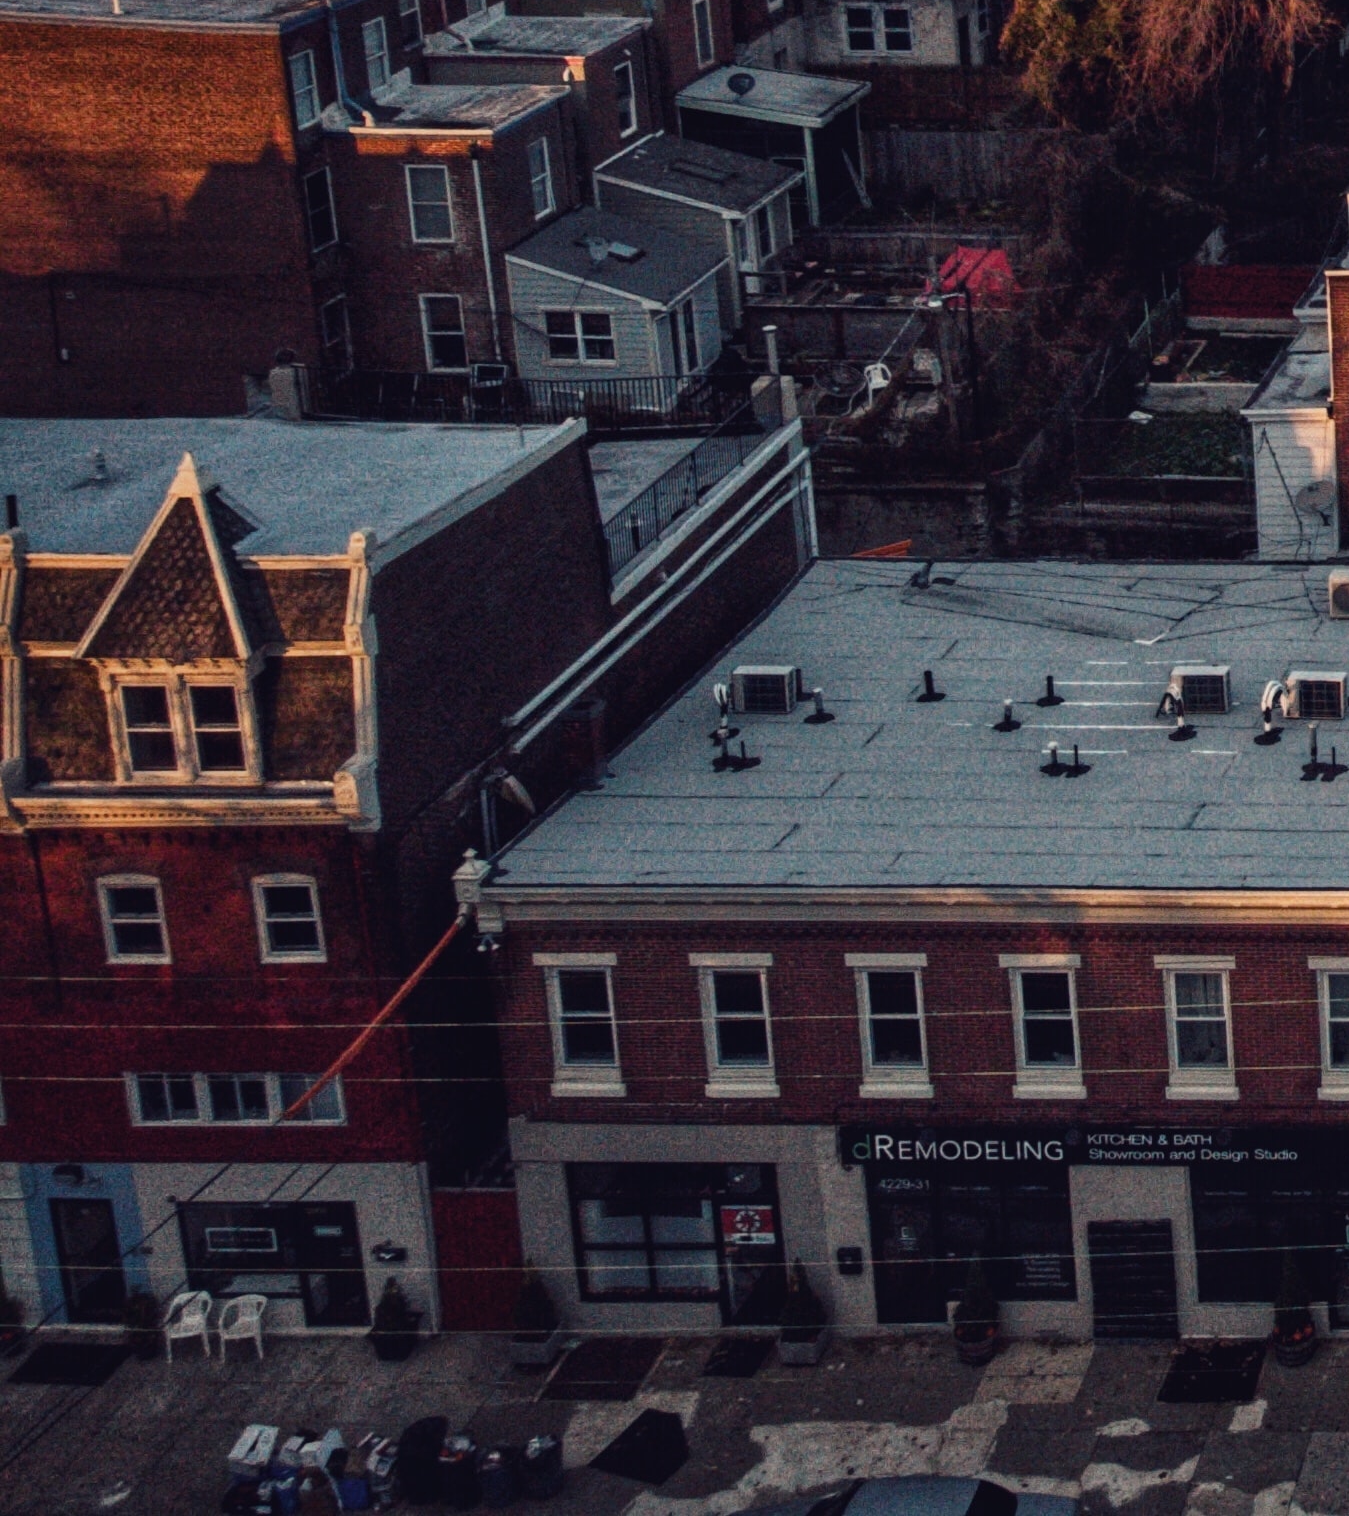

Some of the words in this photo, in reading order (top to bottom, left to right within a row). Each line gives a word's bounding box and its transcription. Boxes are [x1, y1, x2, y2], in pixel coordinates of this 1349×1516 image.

[1086, 1133, 1153, 1146] KITCHEN
[1156, 1133, 1169, 1146] &
[1172, 1133, 1213, 1146] BATH
[1088, 1148, 1165, 1160] Showroom
[1169, 1148, 1196, 1160] and
[1199, 1148, 1249, 1163] Design
[1253, 1148, 1299, 1160] Studio
[878, 1178, 931, 1191] 4229-31
